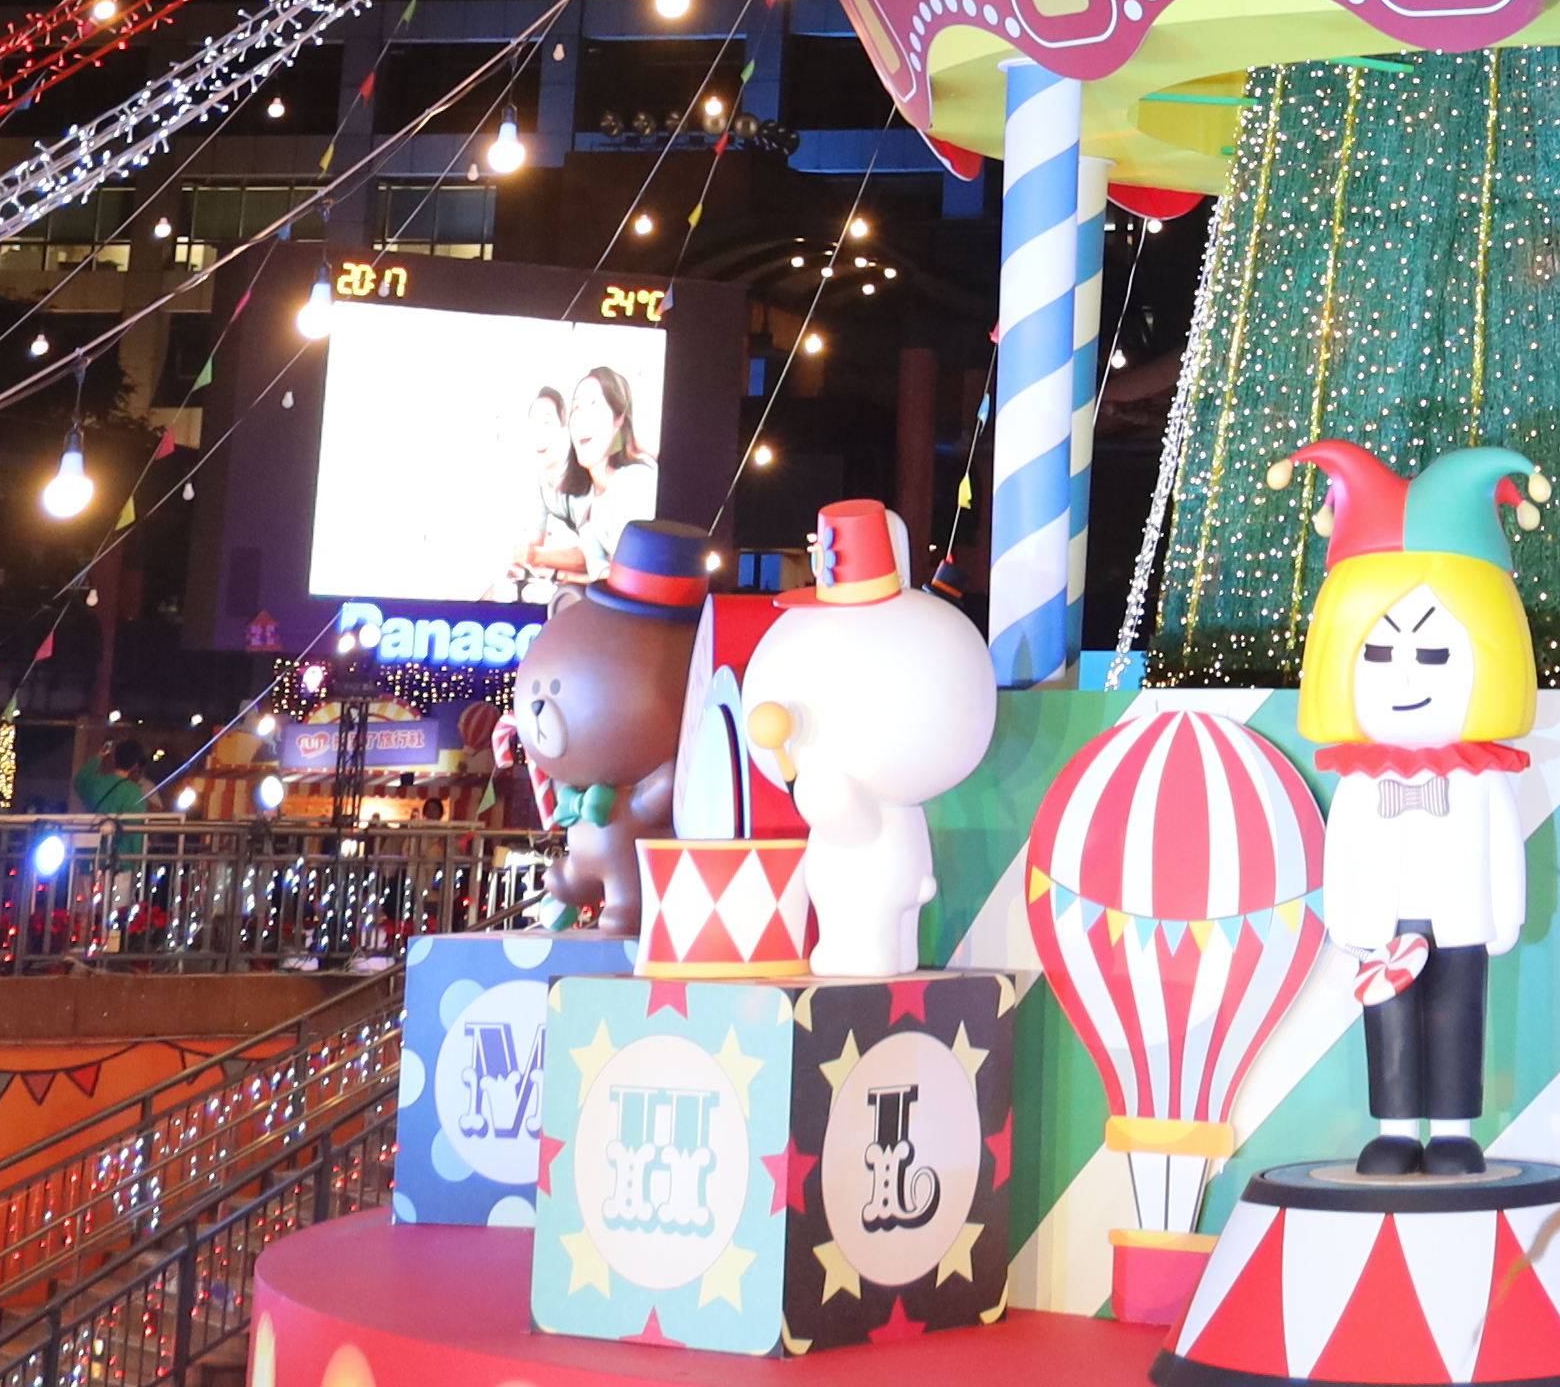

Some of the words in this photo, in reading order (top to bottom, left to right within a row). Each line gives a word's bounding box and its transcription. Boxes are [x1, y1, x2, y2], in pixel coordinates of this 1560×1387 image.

[459, 1022, 546, 1139] M
[602, 1084, 722, 1240] H
[862, 1084, 941, 1233] L
